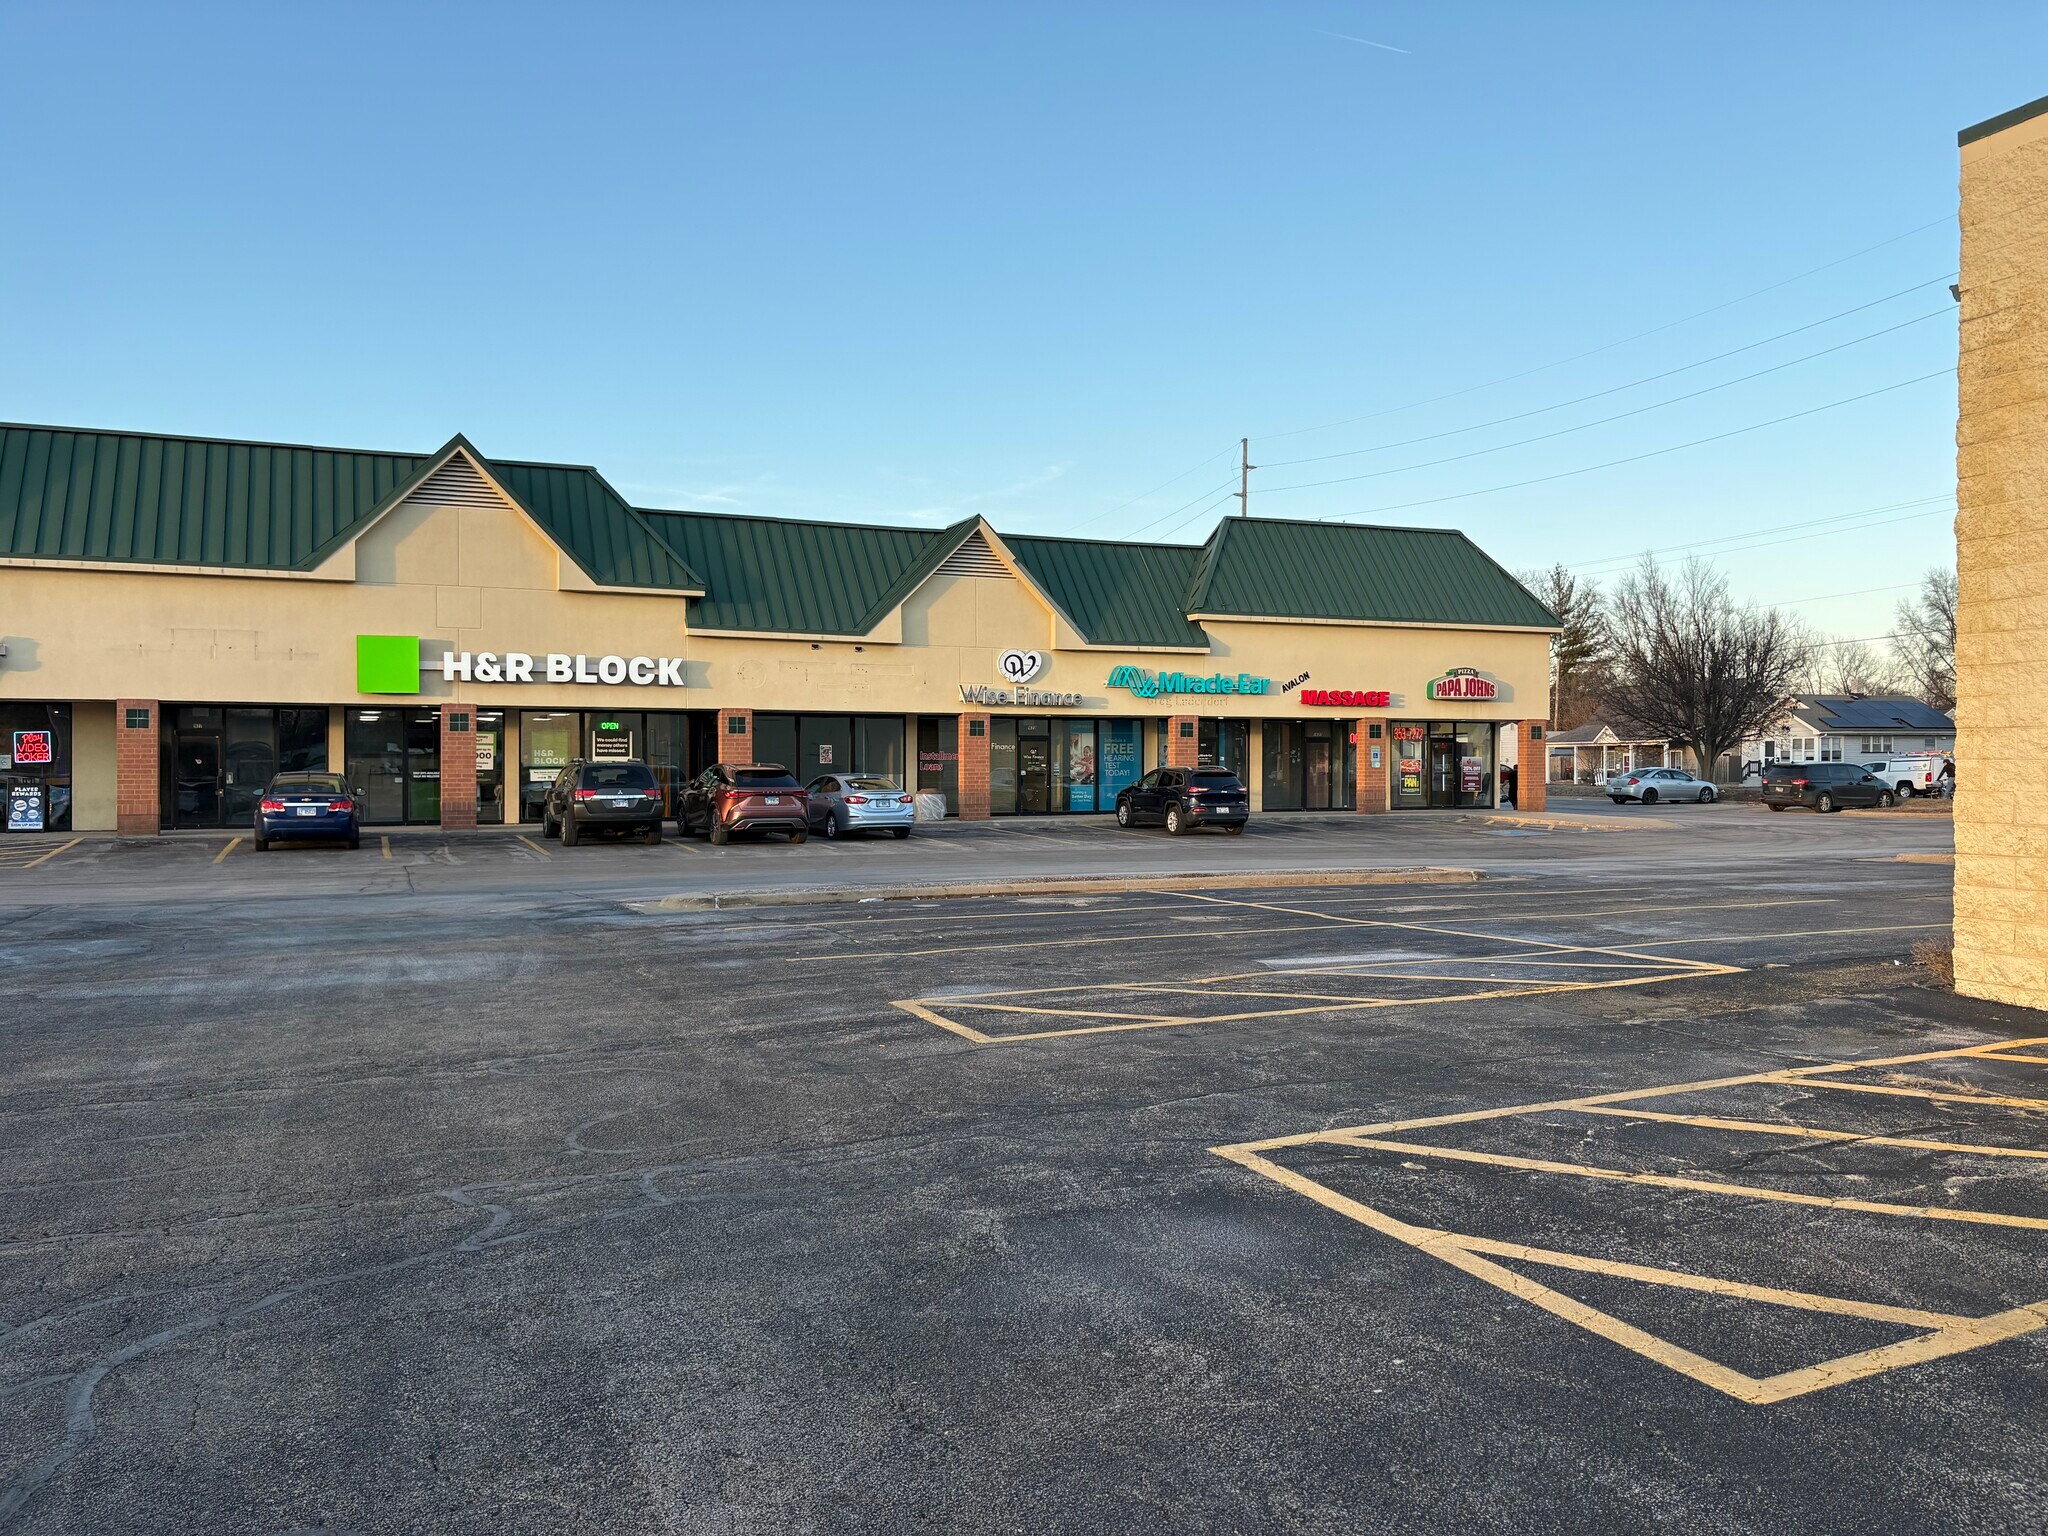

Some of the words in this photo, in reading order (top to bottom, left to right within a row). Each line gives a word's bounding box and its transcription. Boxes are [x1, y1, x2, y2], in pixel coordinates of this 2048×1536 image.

[443, 652, 534, 683] H&R
[547, 653, 684, 686] BLOCK
[1159, 672, 1271, 695] Miracle-Ear
[1281, 671, 1310, 693] AVALON
[1436, 679, 1462, 697] PAPA
[957, 684, 1009, 705] Wise
[1014, 686, 1084, 706] Finance
[1301, 690, 1390, 707] MASSAGE
[601, 722, 619, 730] OPEN
[22, 734, 43, 743] Play
[17, 743, 49, 752] VIDEO
[991, 742, 1016, 750] Finance
[1104, 743, 1134, 754] FREE
[17, 753, 49, 761] POKER
[534, 749, 554, 757] H&R
[920, 761, 943, 771] Loans
[1105, 769, 1130, 777] TODAY!
